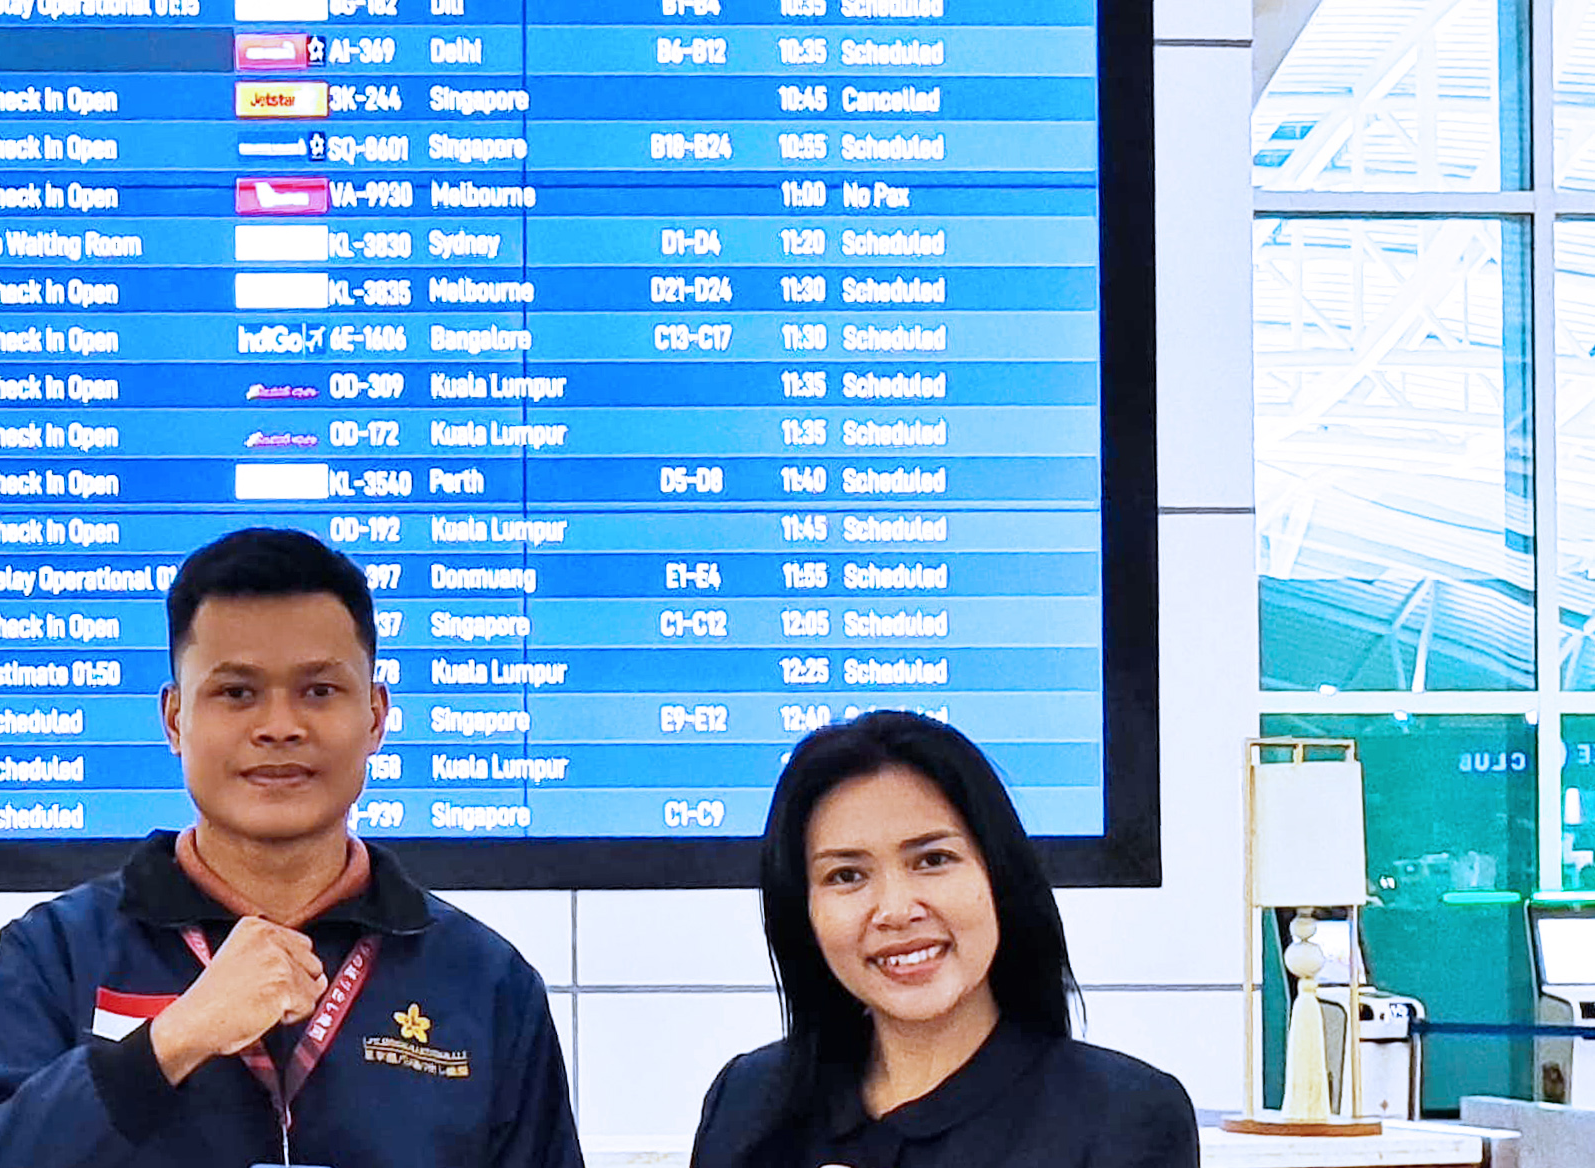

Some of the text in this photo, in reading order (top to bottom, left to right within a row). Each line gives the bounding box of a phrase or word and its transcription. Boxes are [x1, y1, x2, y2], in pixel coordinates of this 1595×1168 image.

[430, 38, 482, 63] Delhi
[841, 39, 944, 66] Scheduled
[44, 86, 64, 112] In
[67, 86, 118, 115] Open
[250, 92, 295, 107] Jetstar
[430, 85, 529, 115] Singapore
[842, 86, 941, 112] Cancelled
[44, 135, 64, 159] In
[66, 134, 118, 164] Open
[428, 133, 528, 163] Singapore
[841, 134, 944, 160] Scheduled
[45, 183, 64, 208] In
[67, 182, 118, 212] Open
[431, 181, 536, 208] Melbourne
[843, 182, 871, 208] No
[873, 182, 910, 208] Pax
[5, 231, 82, 261] Waiting
[85, 231, 142, 257] Room
[428, 230, 501, 259] Sydney
[842, 230, 945, 256] Scheduled
[45, 278, 65, 304] In
[67, 279, 119, 308] Open
[429, 277, 534, 303] Melbourne
[842, 277, 945, 303] Scheduled
[45, 327, 65, 352] In
[68, 327, 119, 356] Open
[430, 325, 532, 355] Bangalore
[843, 325, 946, 351] Scheduled
[45, 375, 65, 399] In
[67, 374, 119, 403] Open
[431, 373, 487, 399] Kuala
[490, 373, 567, 402] Lumpur
[843, 372, 946, 398] Scheduled
[45, 423, 65, 447] In
[68, 422, 119, 451] Open
[430, 421, 487, 448] Kuala
[490, 422, 568, 450] Lumpur
[843, 420, 947, 446] Scheduled
[46, 470, 65, 495] In
[68, 470, 119, 499] Open
[429, 468, 484, 493] Perth
[842, 467, 946, 493] Scheduled
[46, 519, 66, 544] In
[68, 518, 119, 547] Open
[431, 516, 488, 542] Kuala
[491, 517, 568, 546] Lumpur
[843, 515, 947, 542] Scheduled
[38, 566, 154, 595] Operational
[431, 564, 536, 593] Donmuang
[843, 563, 947, 589] Scheduled
[46, 613, 66, 638] In
[69, 613, 120, 642] Open
[431, 611, 530, 641] Singapore
[844, 610, 948, 637] Scheduled
[72, 661, 121, 686] 01:50
[431, 658, 488, 684] Kuala
[491, 659, 568, 688] Lumpur
[844, 658, 948, 684] Scheduled
[431, 706, 531, 736] Singapore
[432, 754, 570, 783] Kuala Lumpur
[431, 802, 531, 831] Singapore
